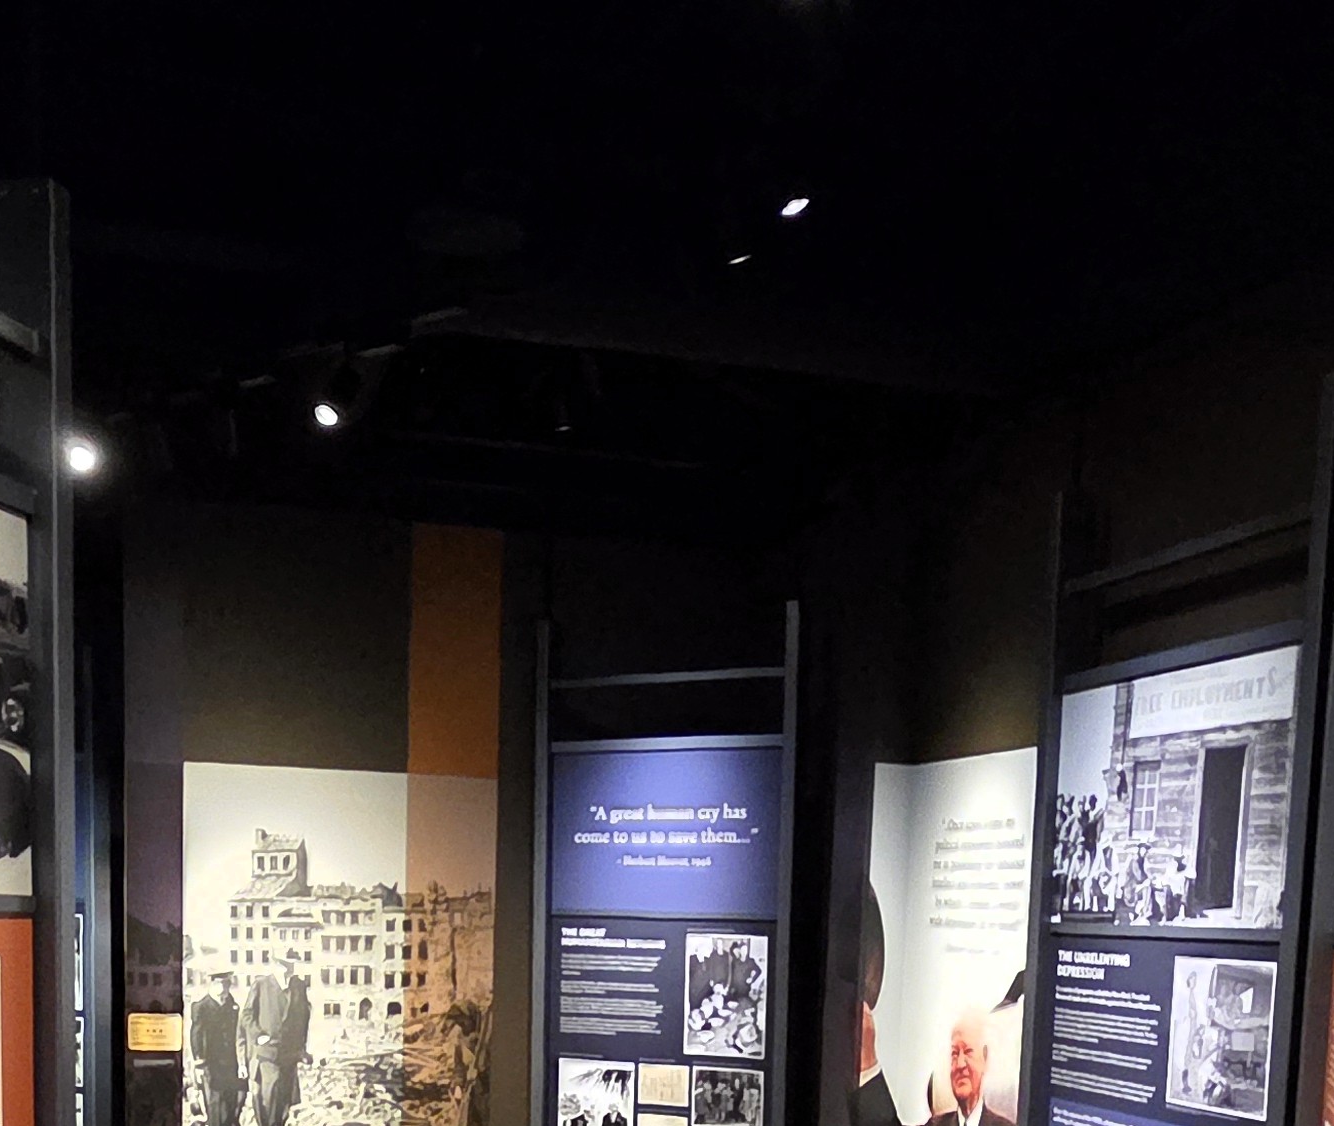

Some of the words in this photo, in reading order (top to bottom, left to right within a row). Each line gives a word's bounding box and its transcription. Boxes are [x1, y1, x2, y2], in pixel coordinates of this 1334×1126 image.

[698, 808, 719, 823] cry
[723, 803, 746, 819] has
[575, 833, 610, 843] come
[614, 831, 628, 843] to
